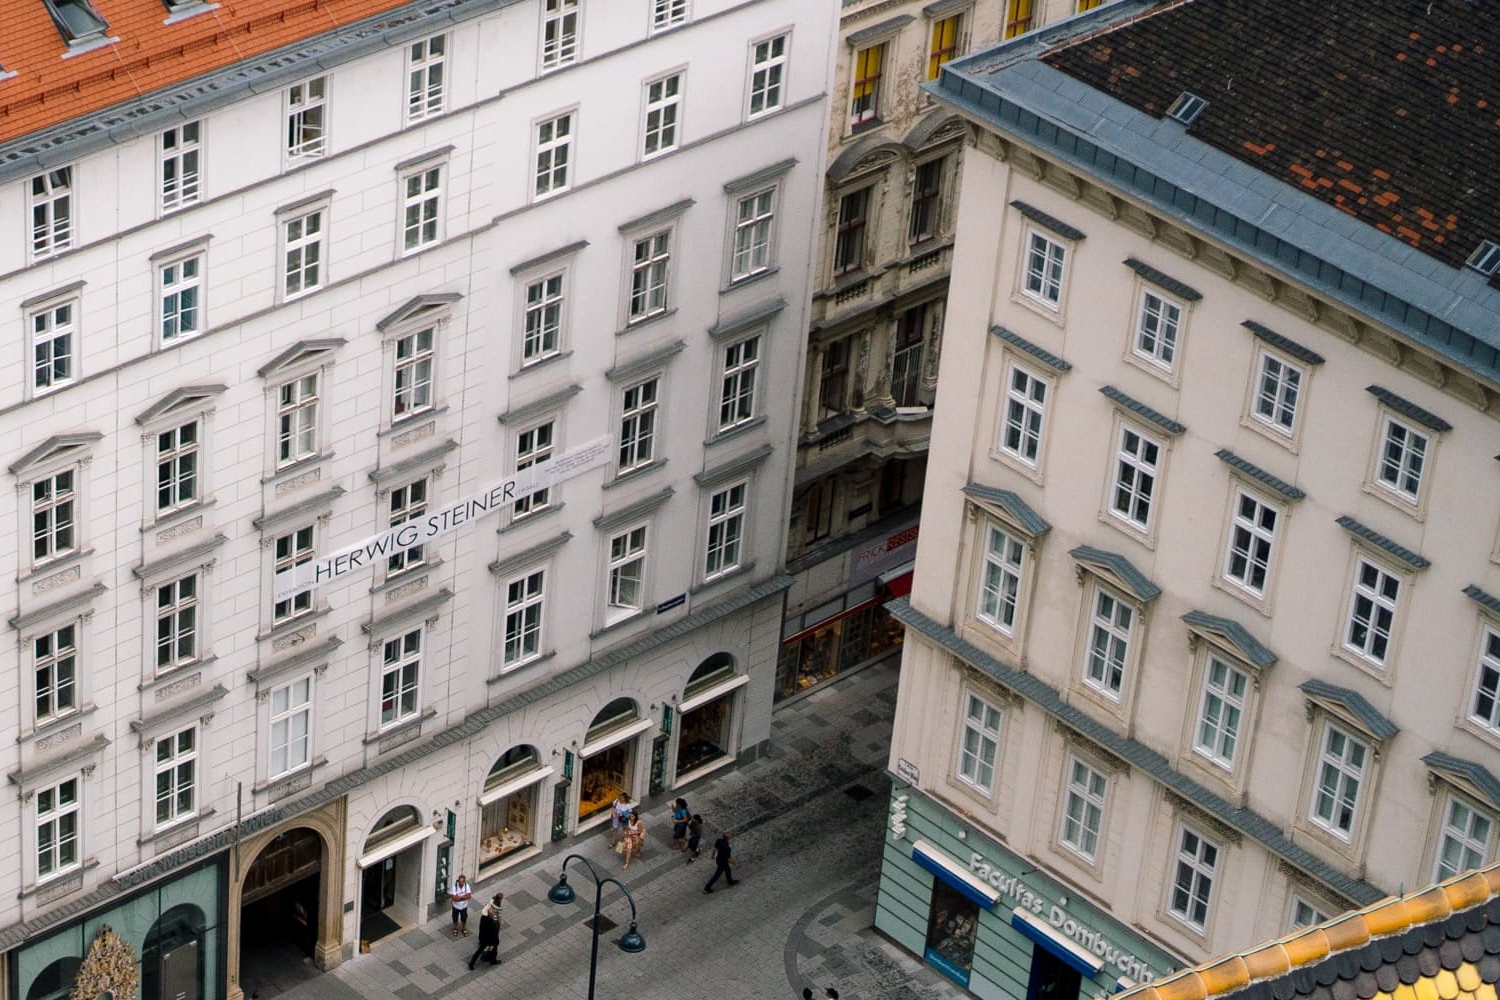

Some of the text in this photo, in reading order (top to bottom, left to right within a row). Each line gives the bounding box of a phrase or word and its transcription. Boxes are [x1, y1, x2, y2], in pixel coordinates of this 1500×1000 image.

[316, 525, 419, 583] HERWIG
[427, 480, 516, 537] STEINER
[969, 852, 1045, 914] Facultas
